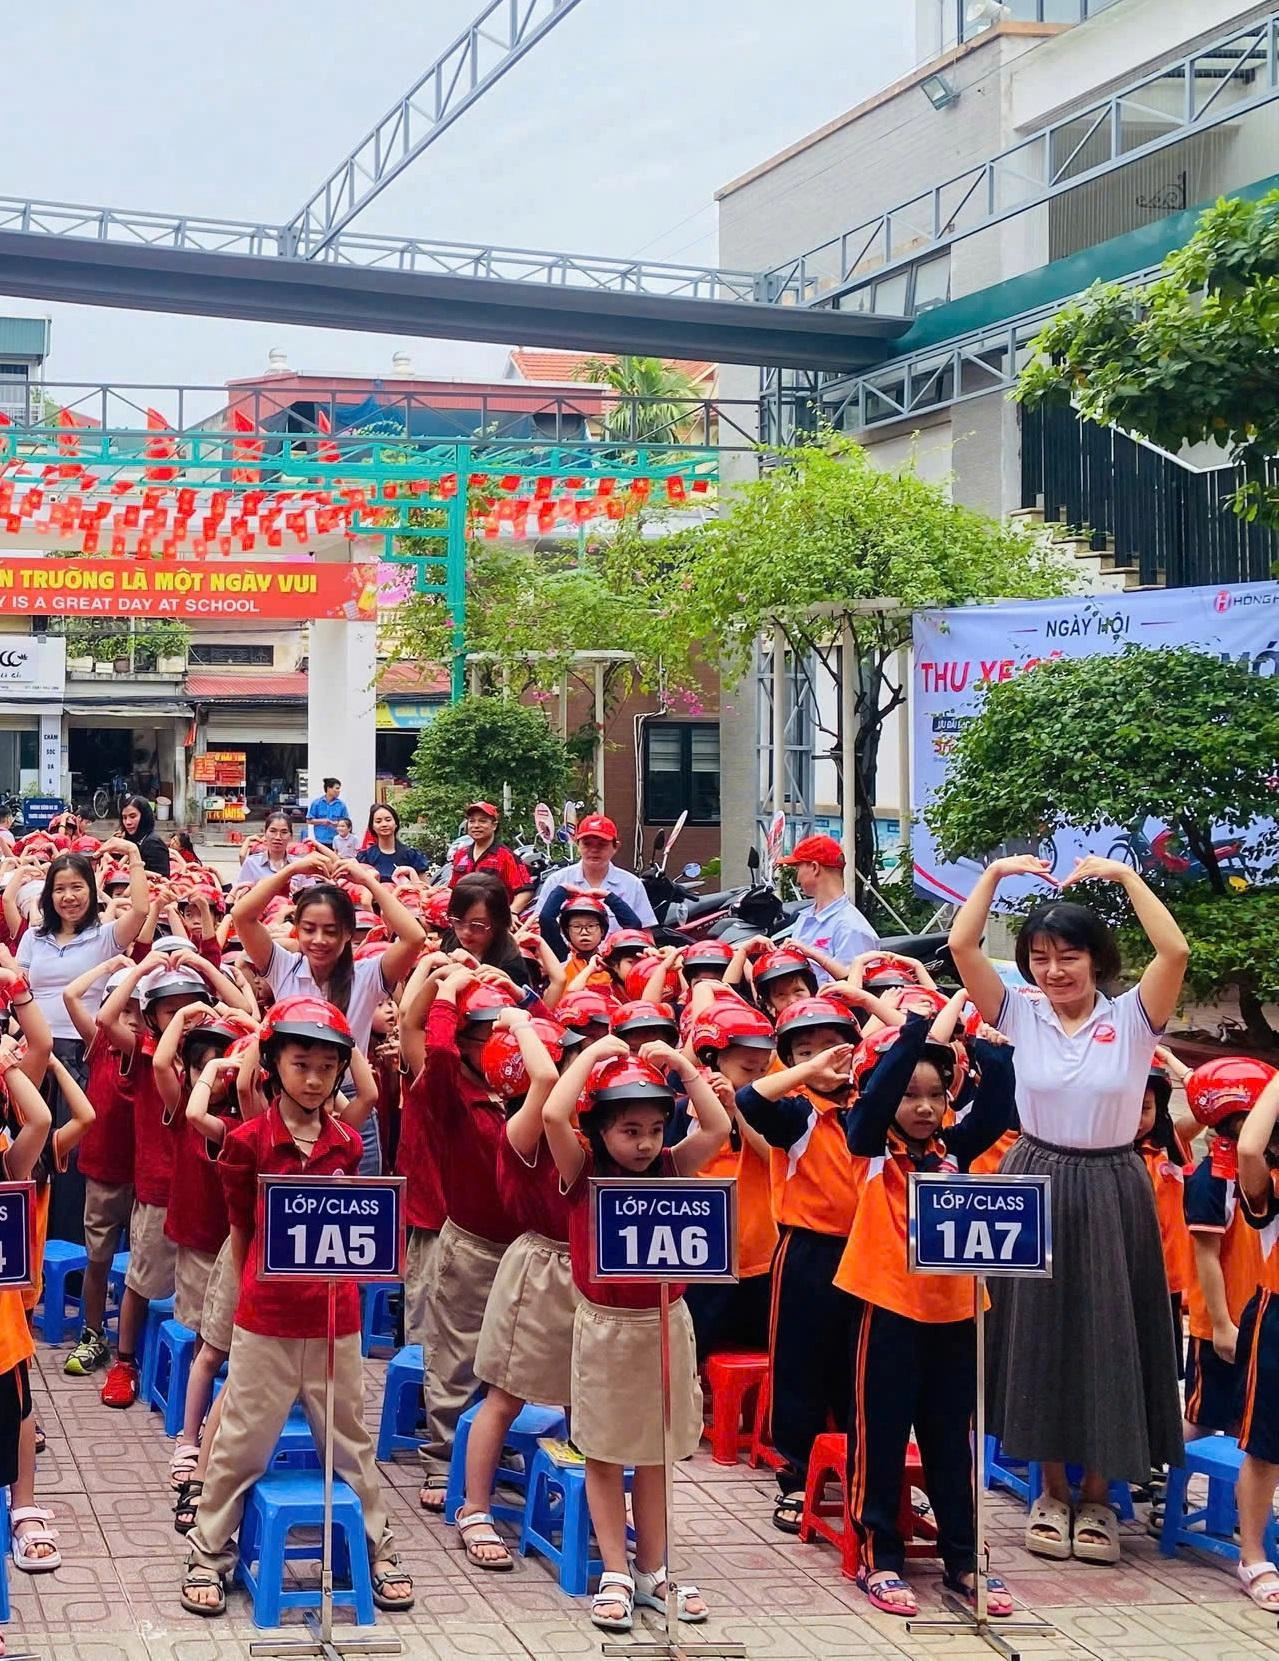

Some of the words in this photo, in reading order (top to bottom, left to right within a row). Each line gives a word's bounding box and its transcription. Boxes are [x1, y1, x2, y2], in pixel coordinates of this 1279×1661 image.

[122, 567, 148, 591] LÀ
[155, 567, 204, 595] MỘT
[210, 569, 271, 593] NGÀY
[278, 574, 317, 593] VUI
[13, 596, 29, 608] IS
[34, 596, 47, 609] A
[52, 596, 112, 610] GREAT
[118, 598, 153, 611] DAY
[158, 598, 179, 611] AT
[185, 599, 260, 613] SCHOOL
[1046, 614, 1091, 637] NGÀY
[921, 661, 970, 693] THU
[285, 1194, 380, 1215] LỚP/CLASS
[615, 1196, 710, 1216] LỚP/CLASS
[932, 1190, 1025, 1211] LỚP/CLASS
[287, 1224, 376, 1266] 1A5
[618, 1225, 709, 1266] 1A6
[936, 1220, 1022, 1260] 1A7
